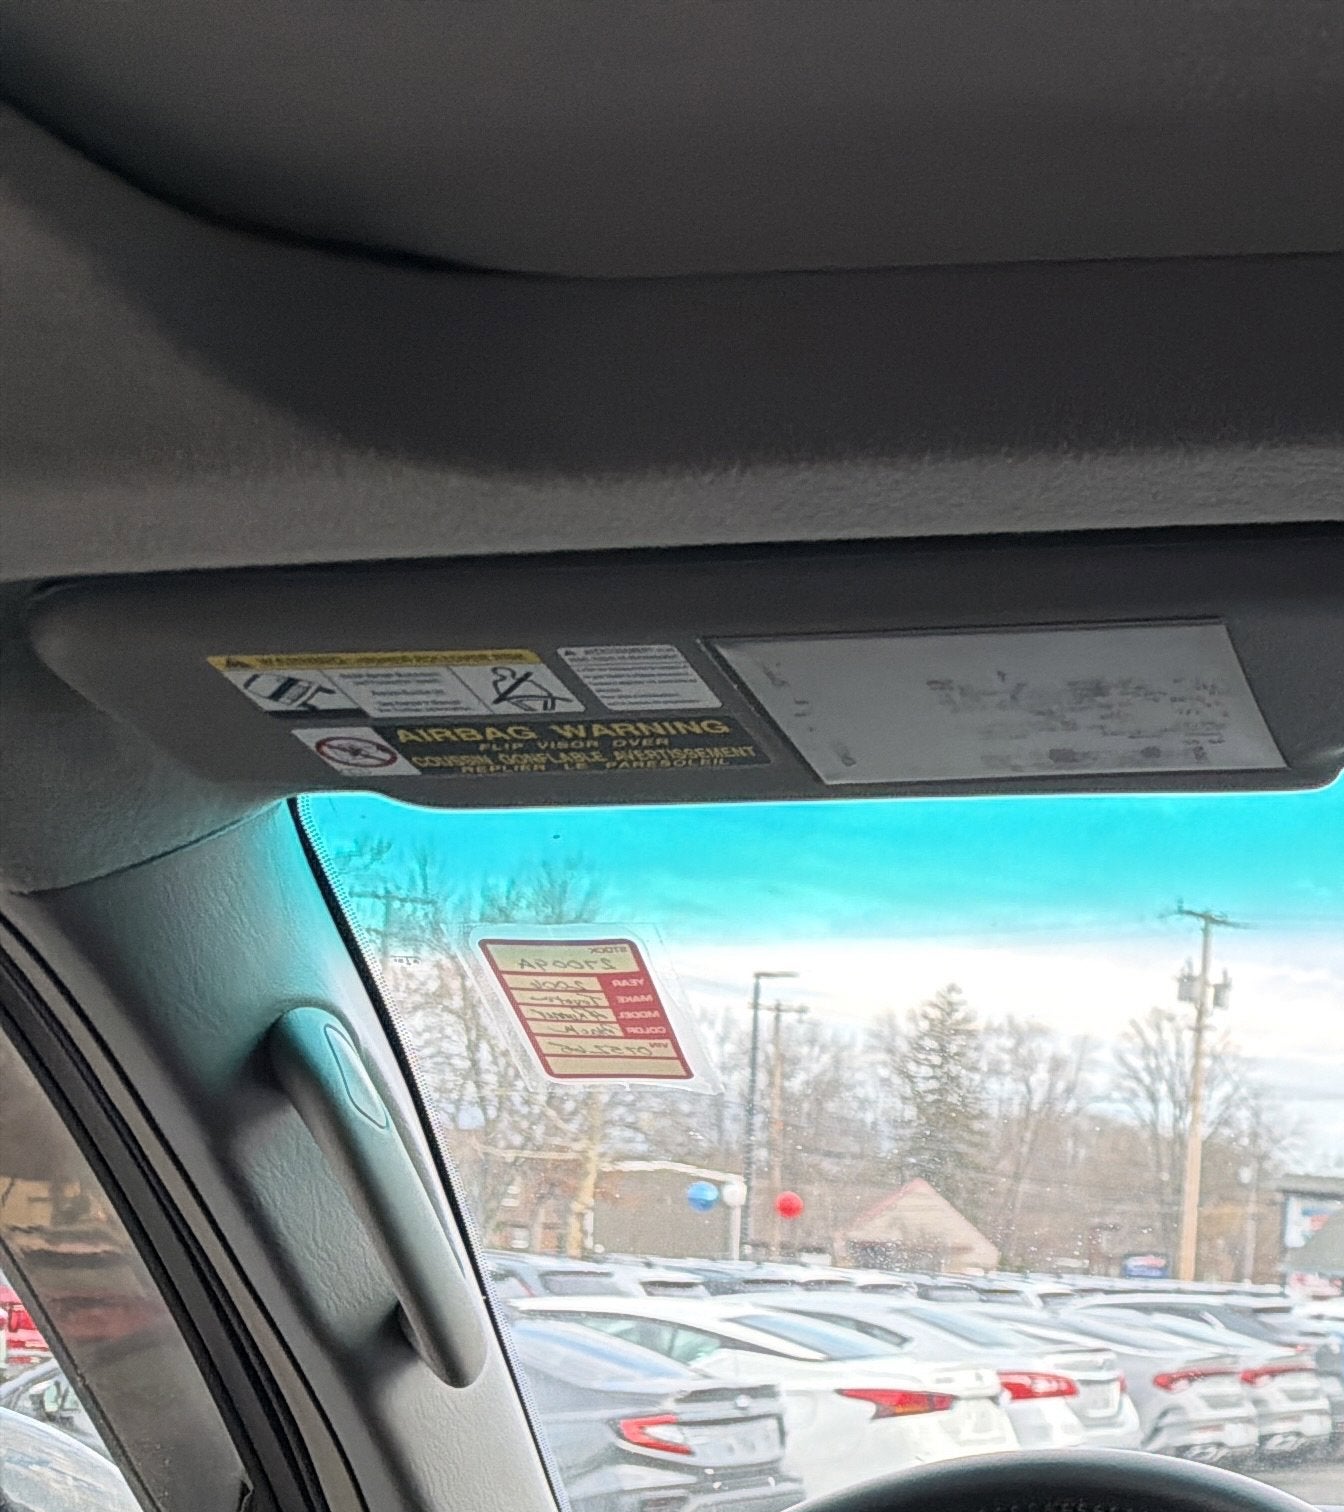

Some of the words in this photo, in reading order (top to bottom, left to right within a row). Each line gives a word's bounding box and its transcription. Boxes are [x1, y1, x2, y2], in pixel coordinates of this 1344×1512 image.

[396, 725, 537, 744] AIRBAG
[550, 720, 730, 740] WARNING
[479, 742, 524, 751] FLIP
[537, 740, 600, 750] VISOR
[612, 738, 669, 748] OVER
